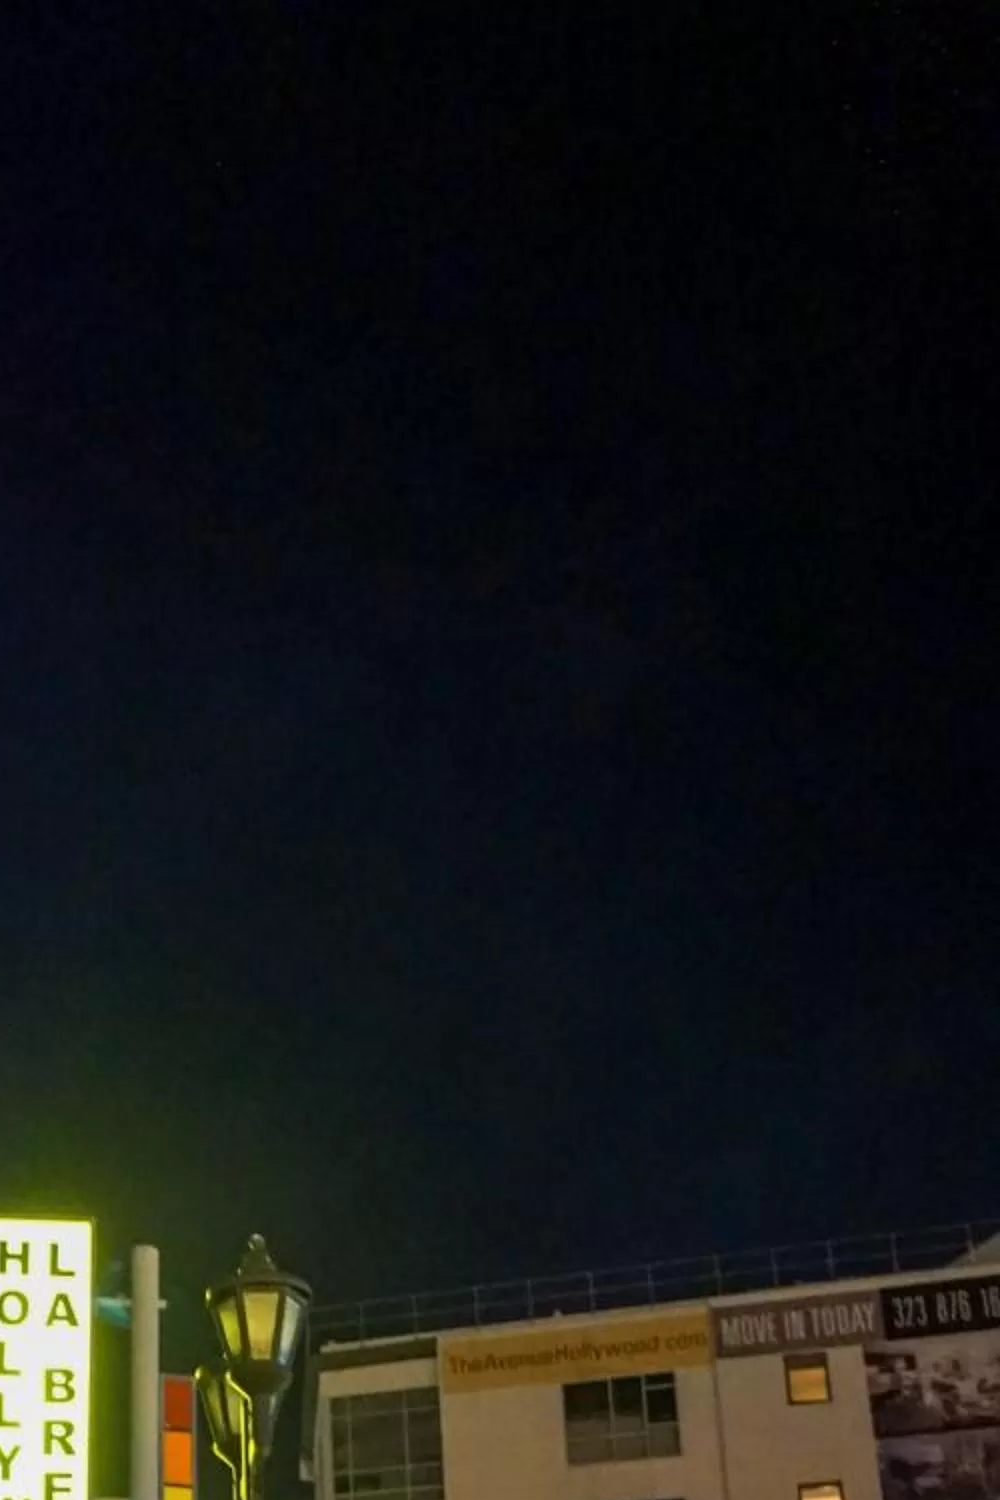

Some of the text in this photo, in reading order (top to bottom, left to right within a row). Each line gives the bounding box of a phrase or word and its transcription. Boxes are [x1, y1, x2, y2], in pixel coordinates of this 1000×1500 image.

[46, 1243, 78, 1328] LA
[720, 1302, 875, 1347] MOVE IN TODAY
[892, 1295, 928, 1329] 323
